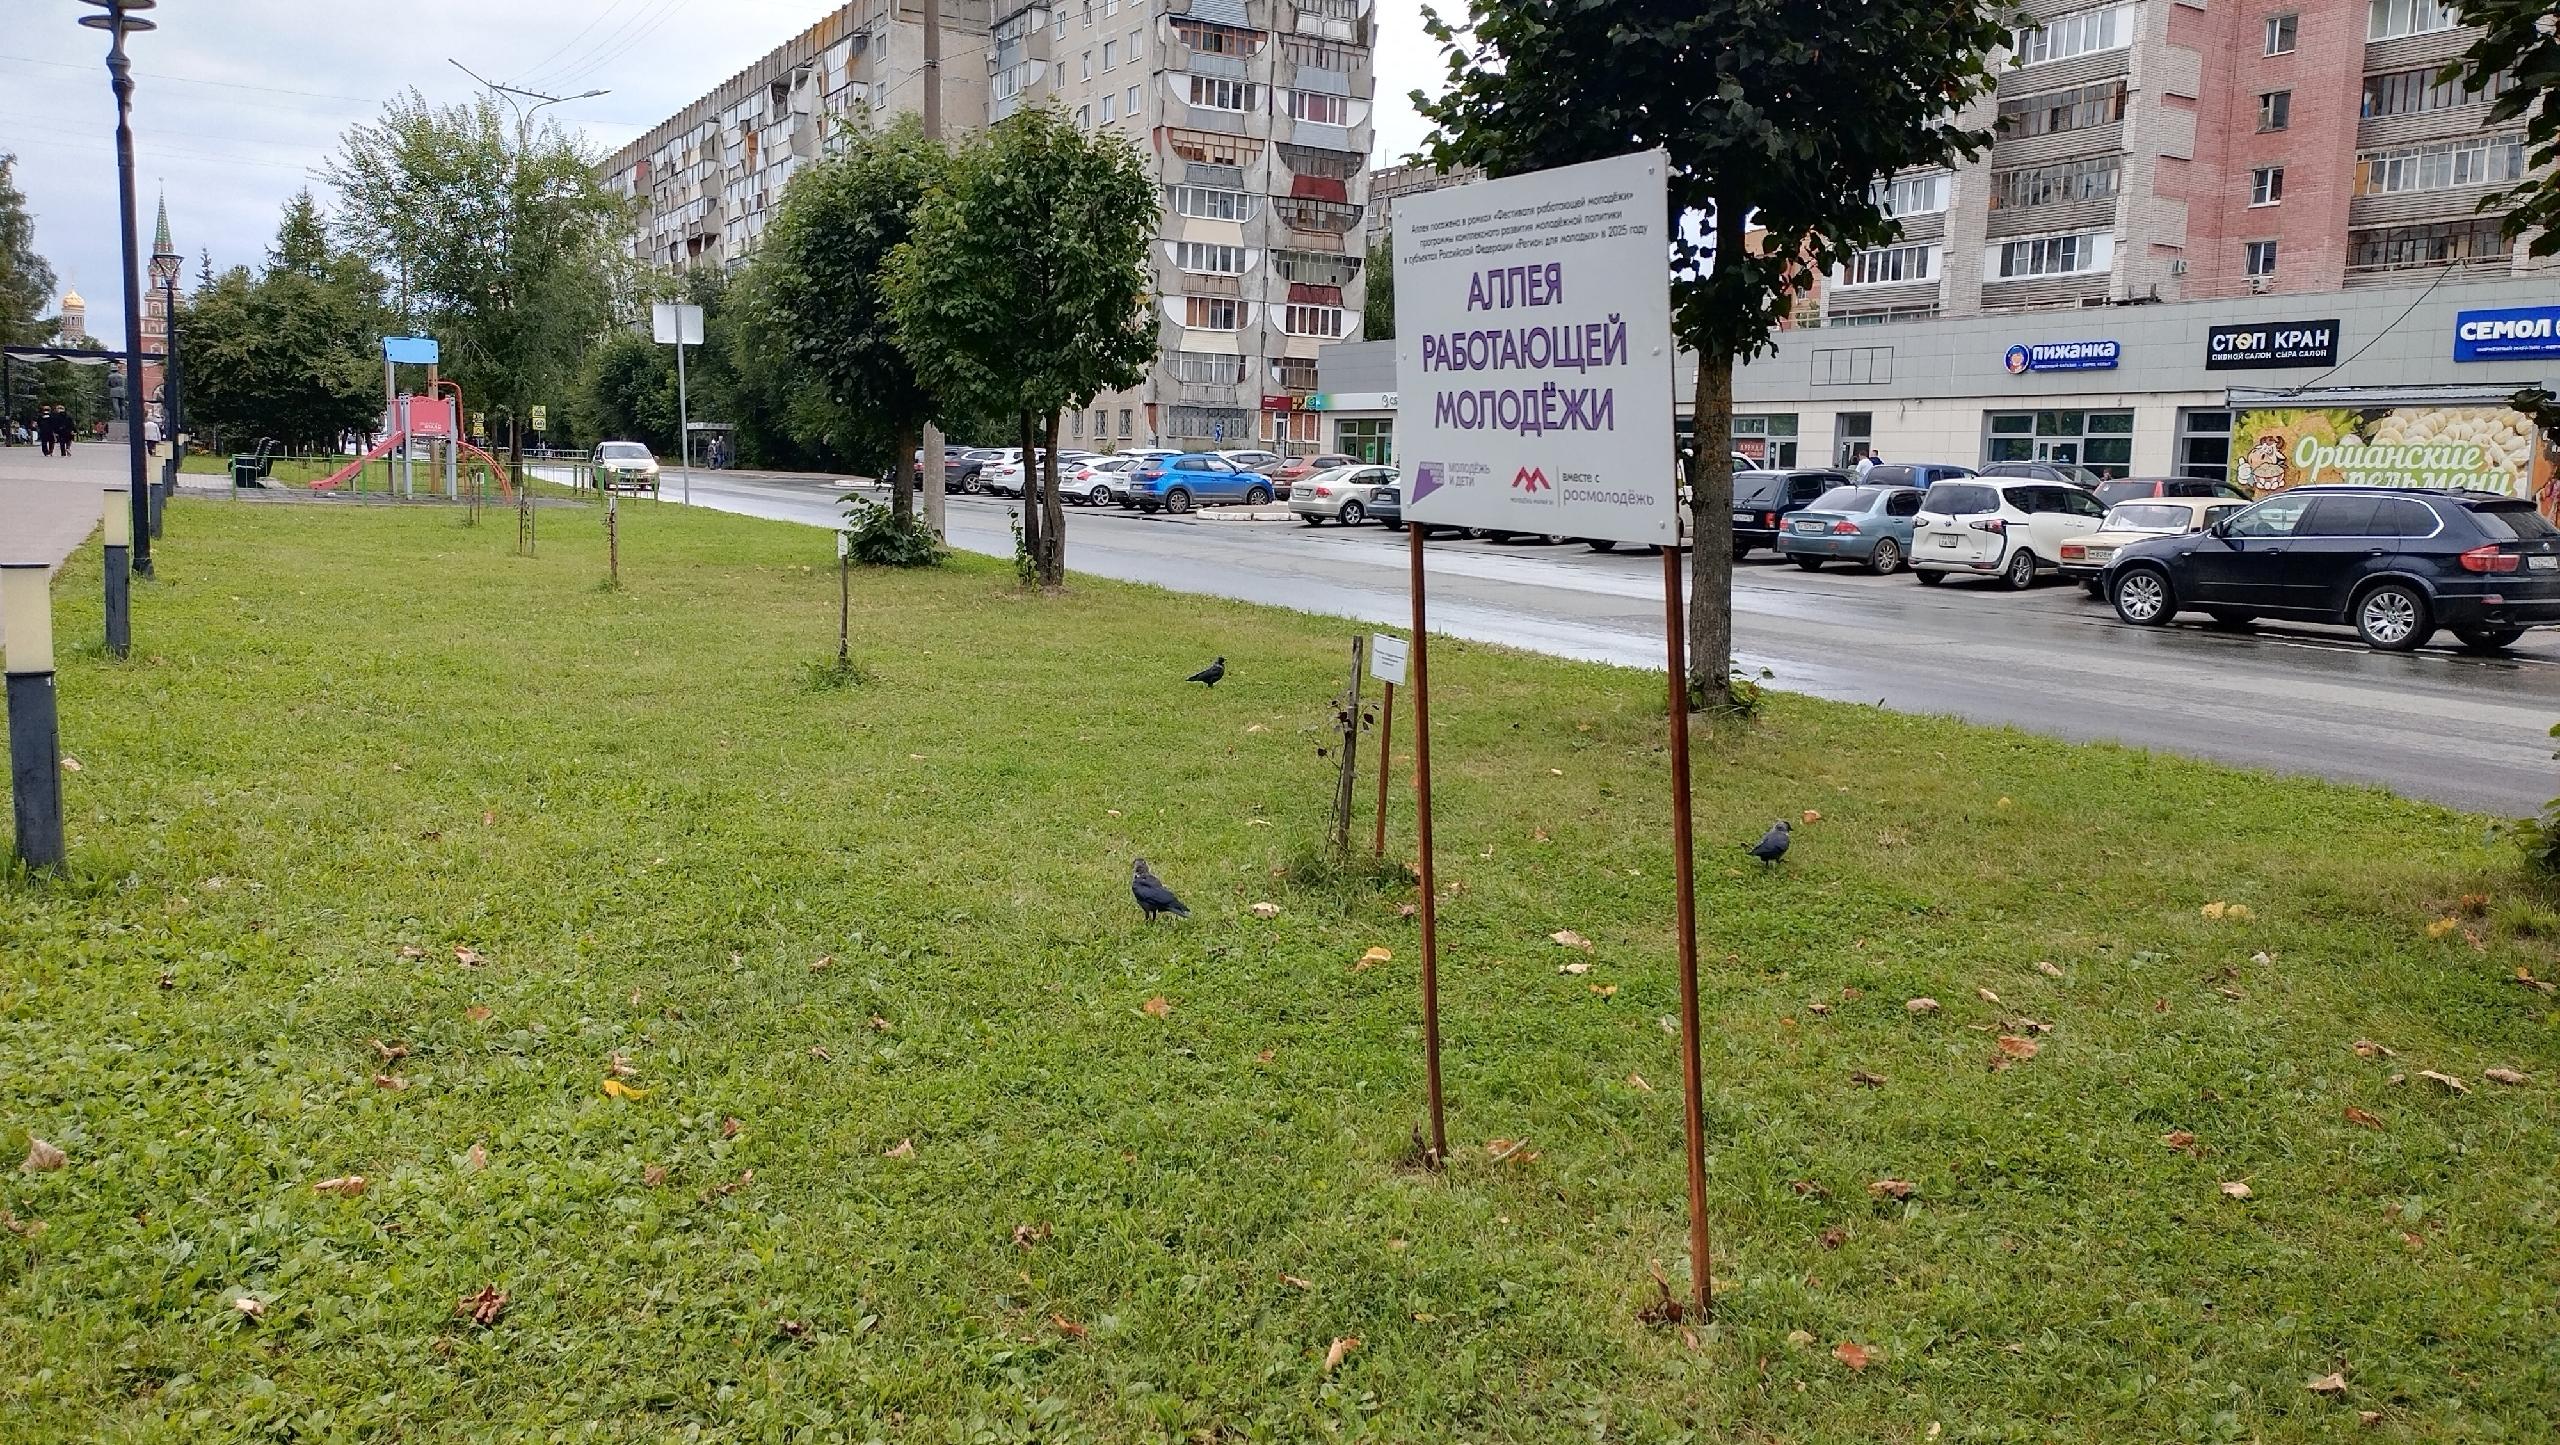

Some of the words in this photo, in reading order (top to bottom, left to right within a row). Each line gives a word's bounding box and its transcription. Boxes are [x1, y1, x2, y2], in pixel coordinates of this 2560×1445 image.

[1537, 197, 1586, 216] работающей
[1501, 223, 1533, 238] развития
[1535, 214, 1583, 230] молодёжной
[1585, 210, 1623, 224] политики
[1439, 246, 1474, 260] Российской
[1475, 242, 1514, 256] Федерации
[1545, 236, 1559, 247] для
[1608, 224, 1628, 238] 2025
[1629, 224, 1649, 236] году
[1467, 262, 1563, 312] АЛЛЕЯ
[2212, 332, 2267, 352] СТОП
[2274, 328, 2330, 349] КРАН
[2460, 318, 2552, 341] СЕМОЛ
[1422, 312, 1628, 375] РАБОТАЮЩЕЙ
[2212, 352, 2244, 361] ПИВНОЙ
[2245, 351, 2272, 360] САЛОН
[2276, 350, 2297, 358] СЫРА
[2299, 349, 2327, 357] САЛОН
[1434, 381, 1615, 437] МОЛОДЁЖИ
[1448, 461, 1491, 475] МОЛОДЁЖЬ
[2294, 435, 2484, 483] Оршанские
[1455, 475, 1476, 487] ДЕТИ
[1562, 472, 1593, 483] вместе
[1563, 488, 1655, 507] росмолодёжь
